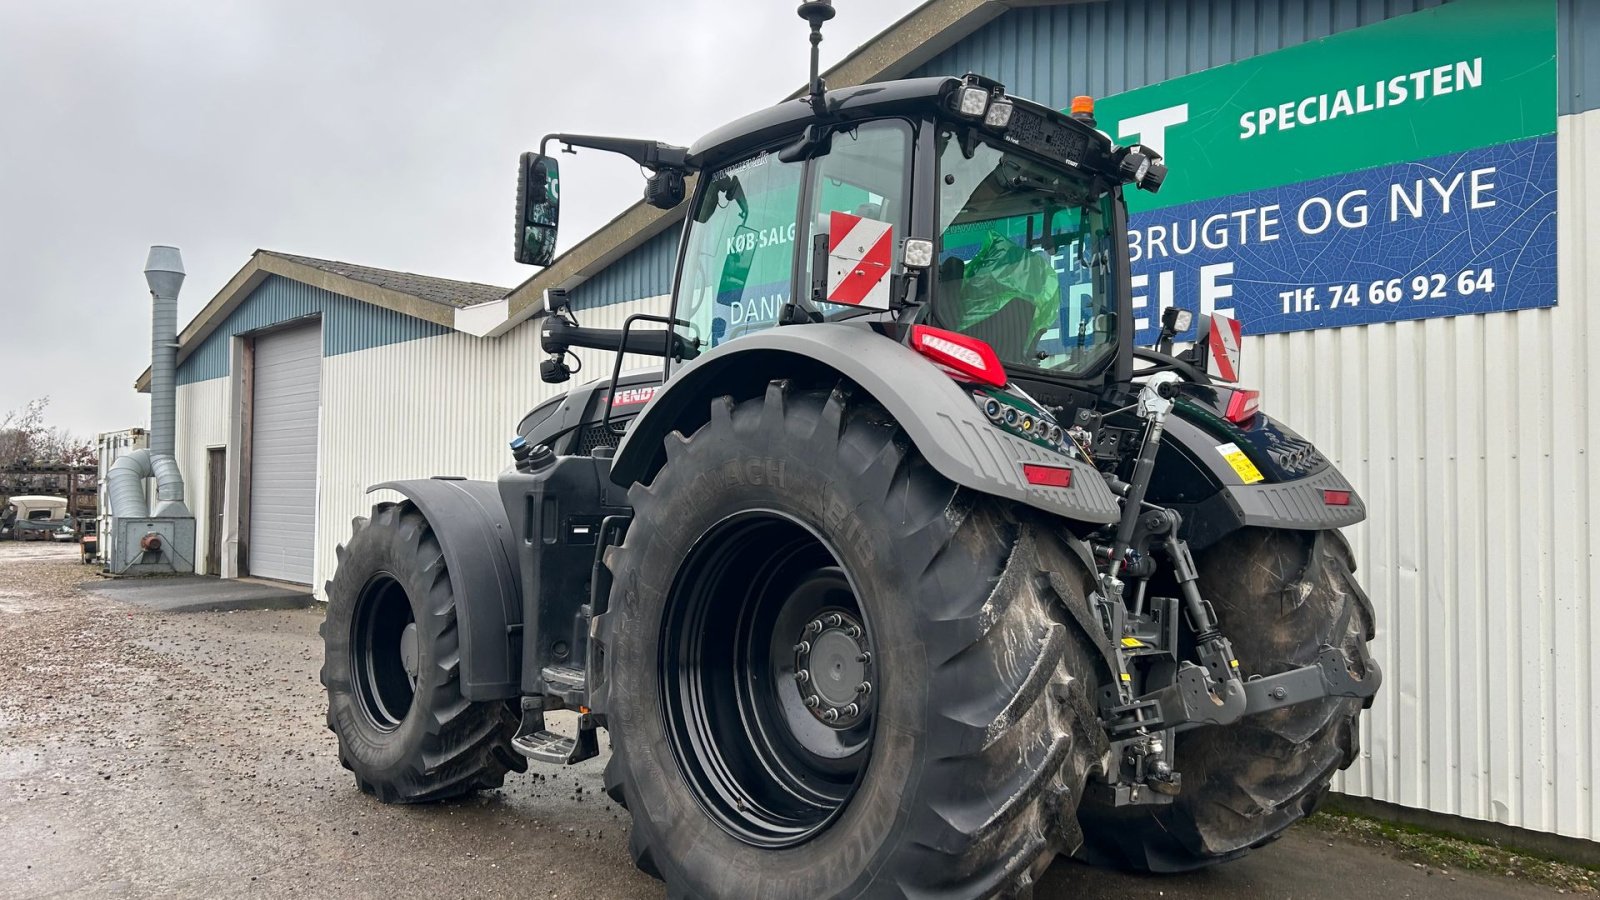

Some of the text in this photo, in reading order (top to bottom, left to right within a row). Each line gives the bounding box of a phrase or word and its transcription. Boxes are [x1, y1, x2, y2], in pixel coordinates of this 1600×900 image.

[1240, 57, 1483, 139] SPECIALISTEN
[1297, 189, 1368, 235] OG
[1390, 166, 1496, 222] NYE
[1279, 268, 1495, 314] Tlf. 74 66 92 64
